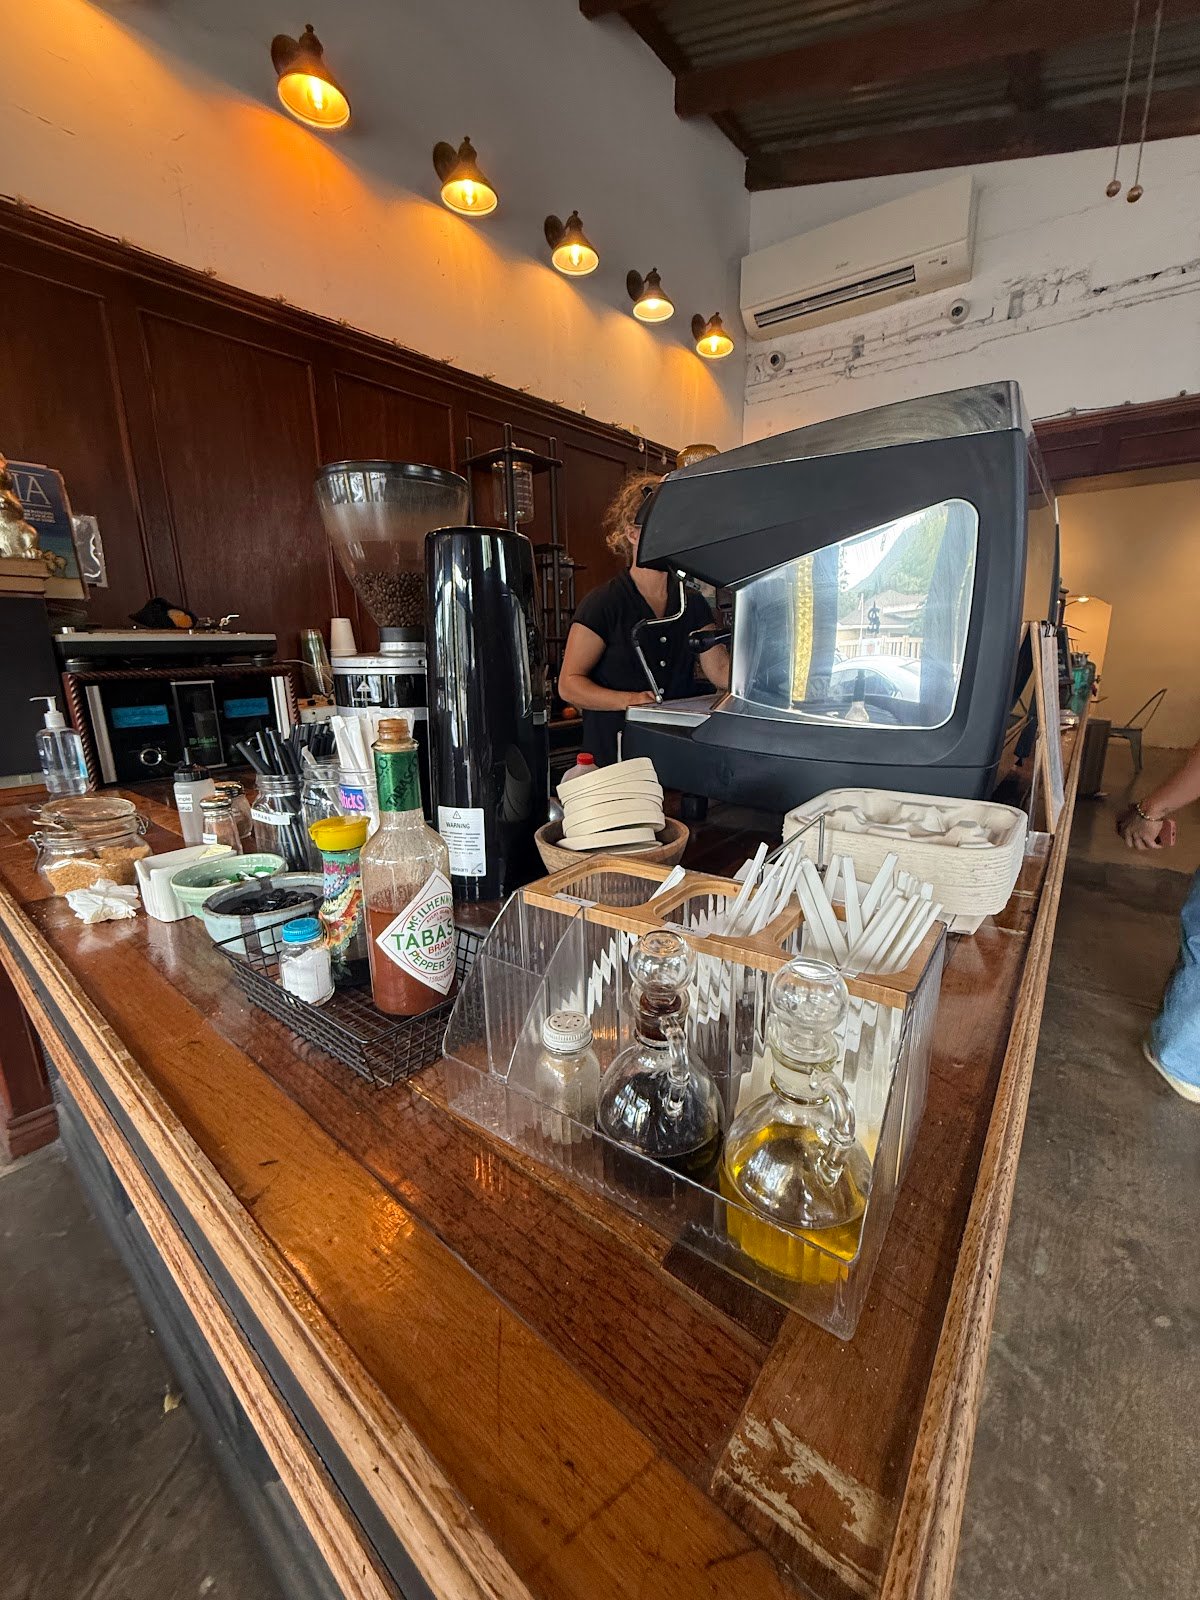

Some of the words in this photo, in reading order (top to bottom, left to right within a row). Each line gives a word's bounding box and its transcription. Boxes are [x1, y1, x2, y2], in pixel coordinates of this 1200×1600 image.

[445, 821, 471, 830] WARNING
[428, 936, 453, 955] BRAND
[408, 950, 446, 972] PEPPER
